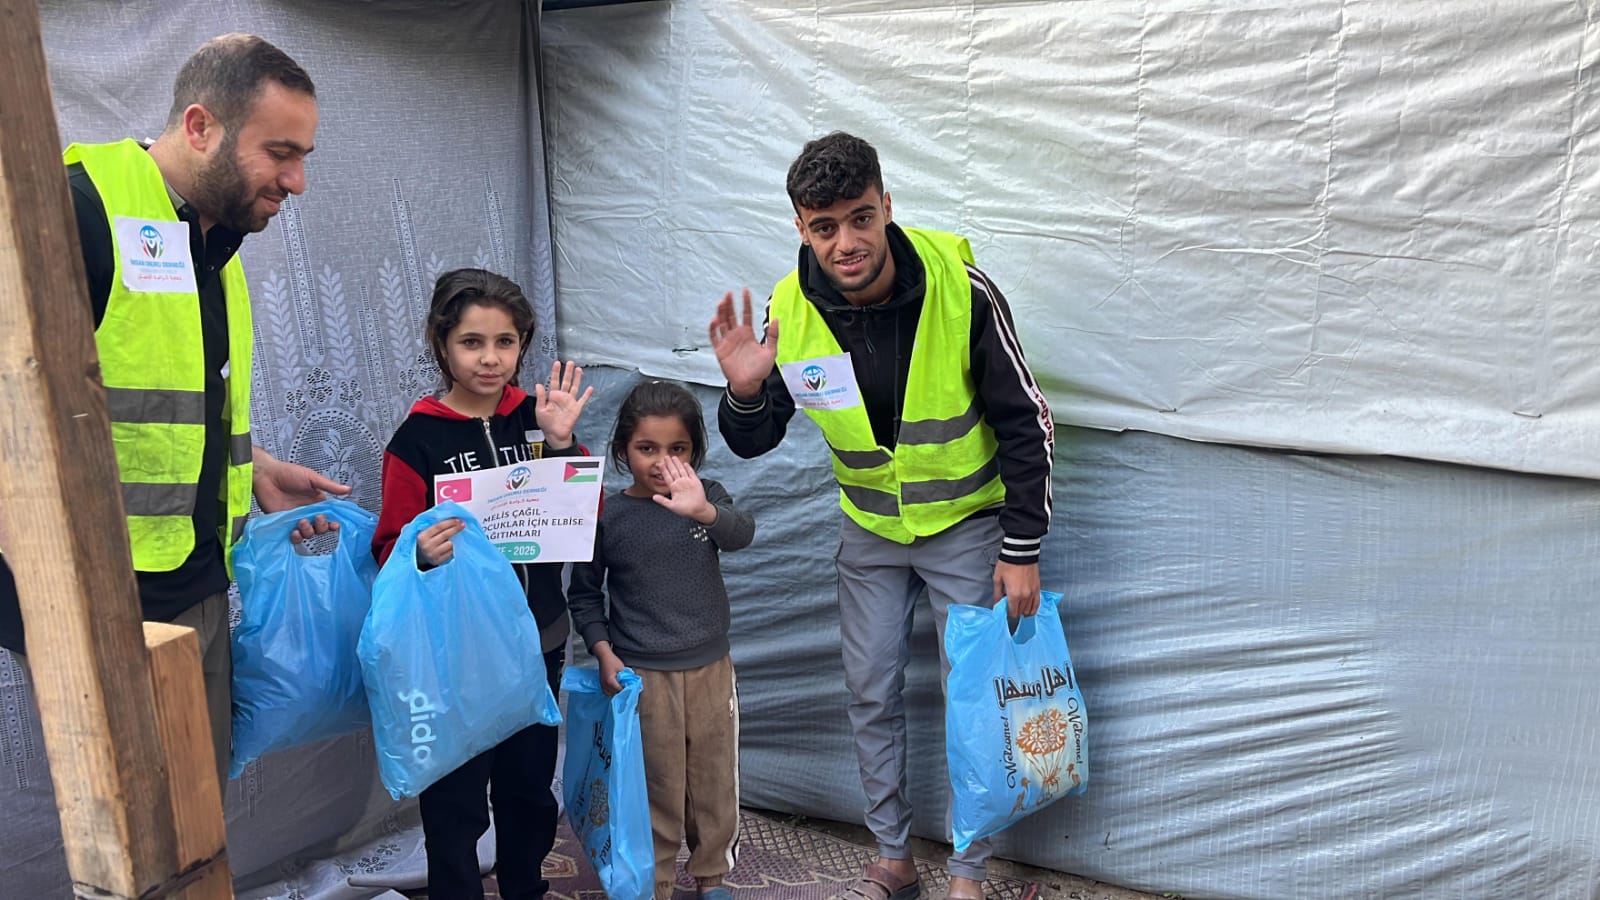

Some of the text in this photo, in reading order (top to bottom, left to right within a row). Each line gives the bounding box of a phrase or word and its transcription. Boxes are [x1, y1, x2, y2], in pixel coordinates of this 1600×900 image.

[512, 506, 541, 518] ÇAĞIL
[527, 517, 549, 529] İÇİN
[551, 517, 584, 526] ELBİSE
[513, 545, 536, 556] 2025
[1067, 697, 1084, 764] Welcome!
[1000, 716, 1018, 789] Welcome!
